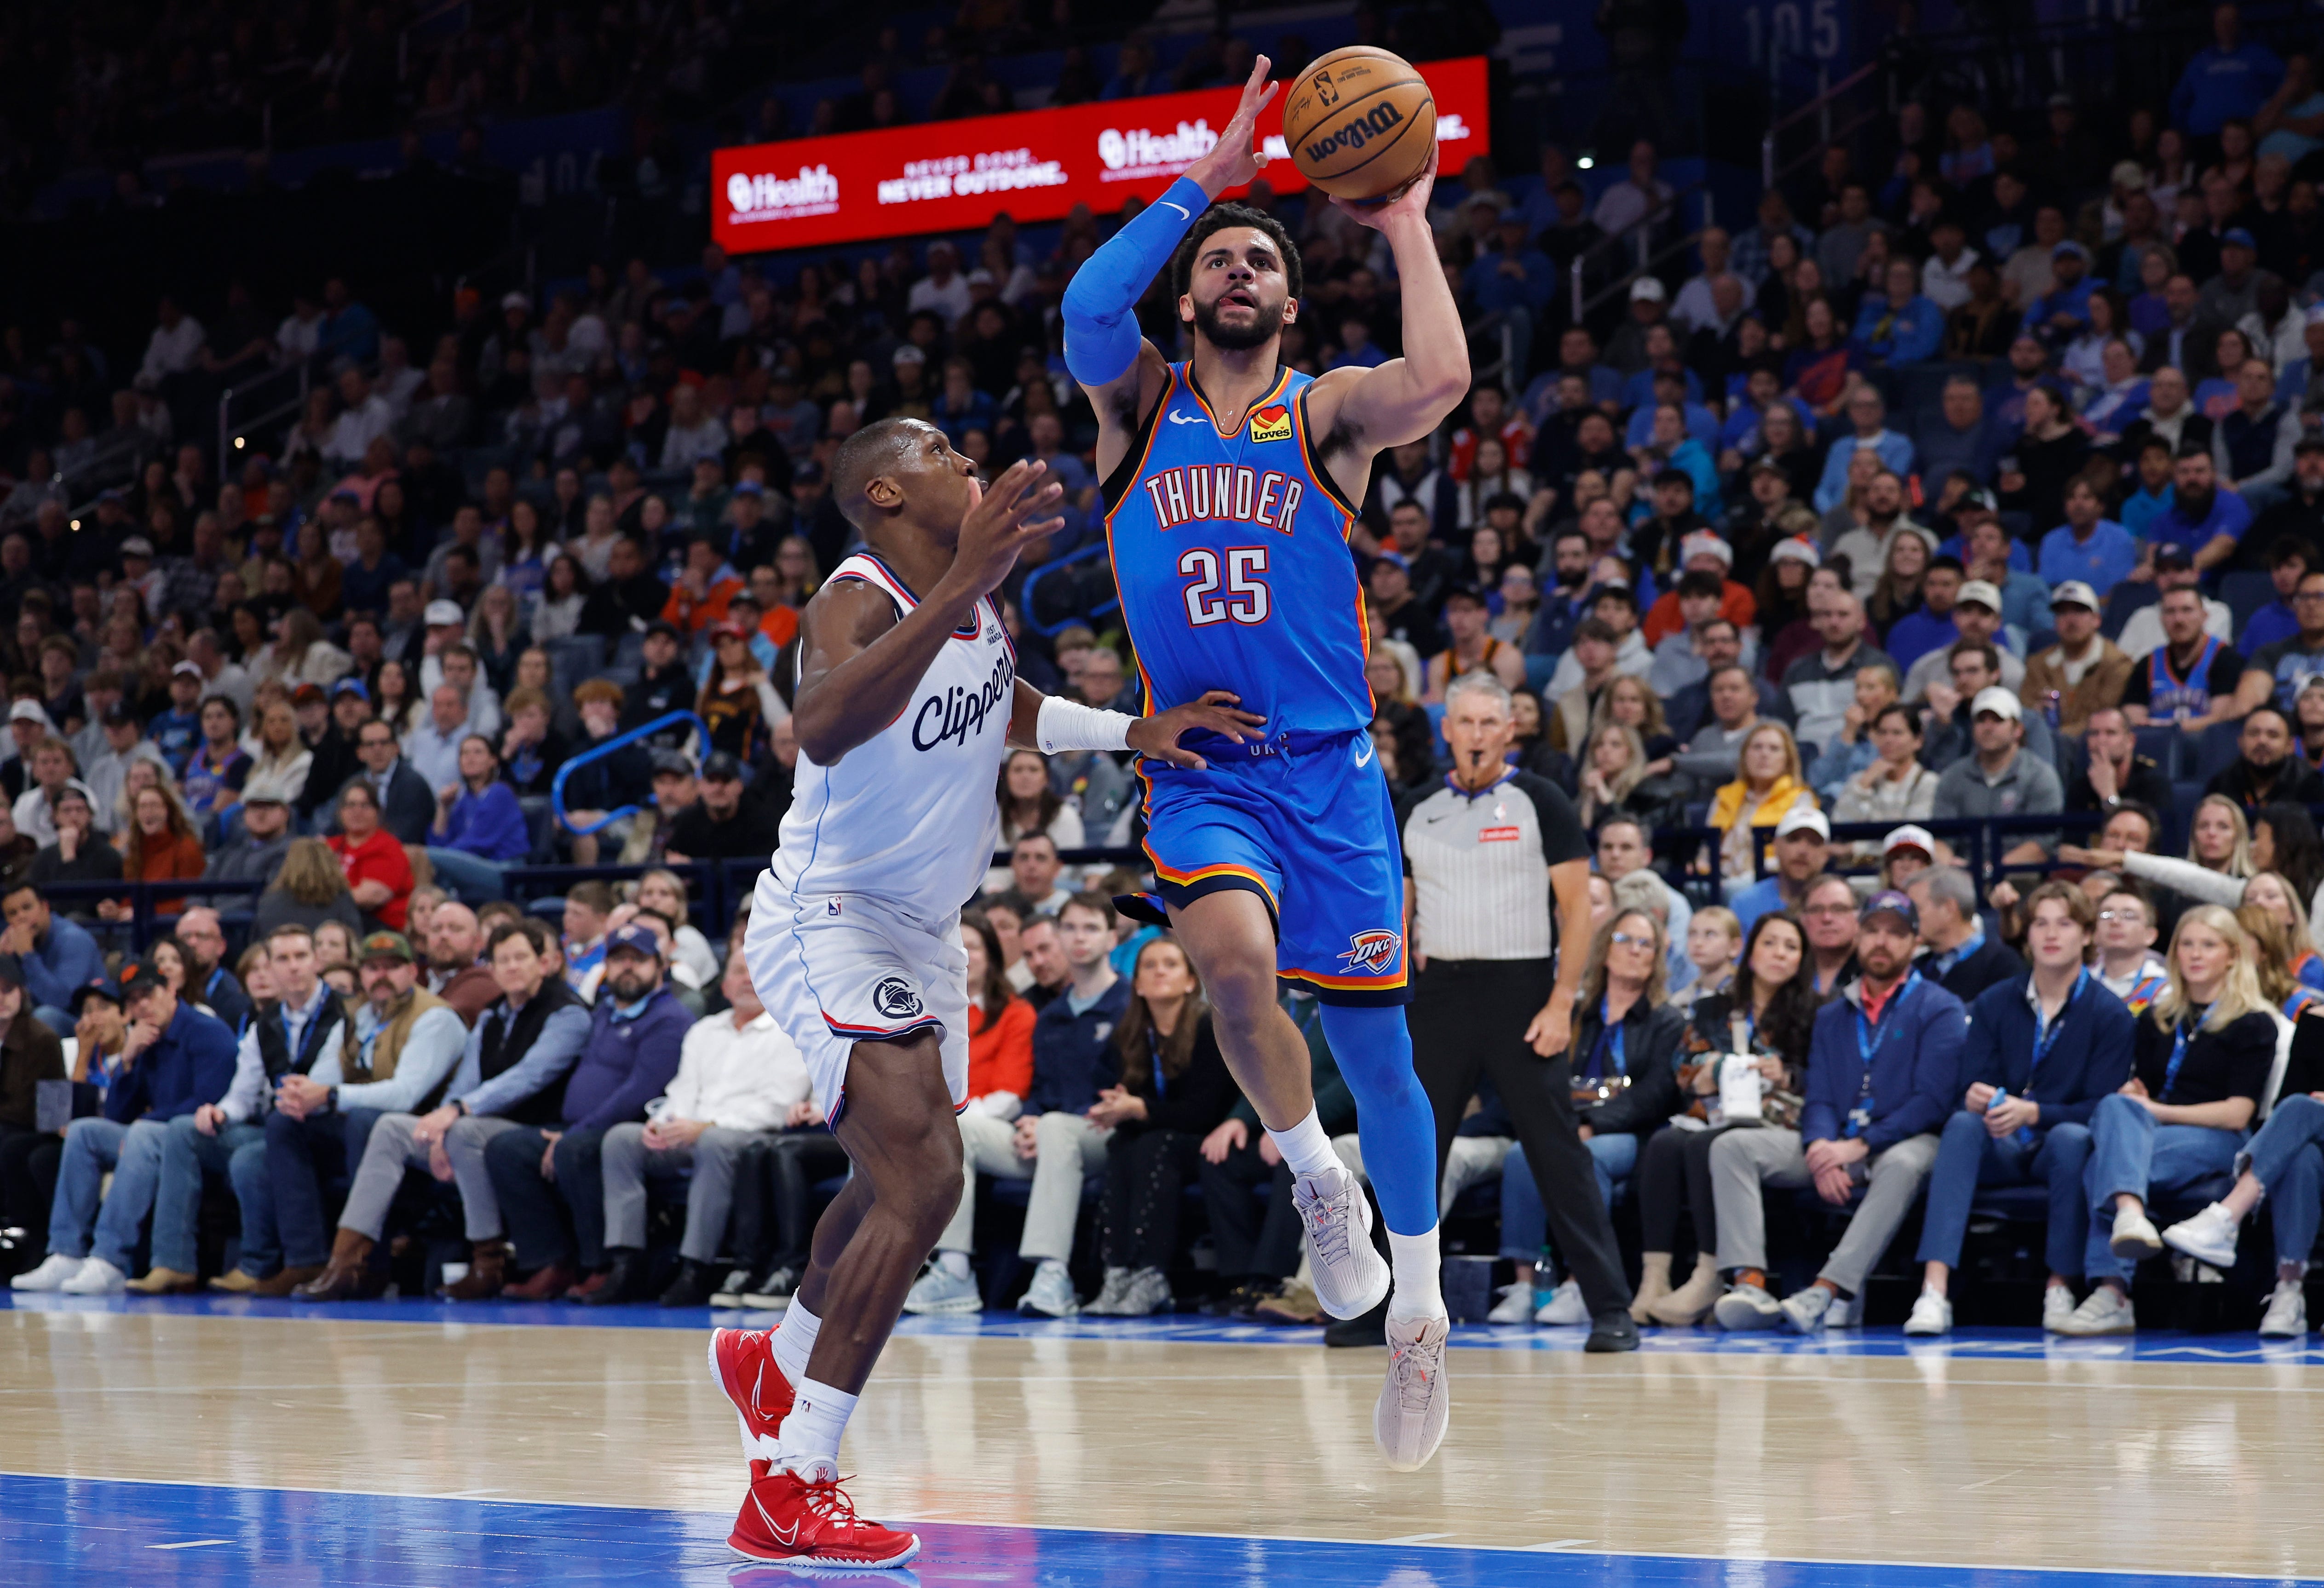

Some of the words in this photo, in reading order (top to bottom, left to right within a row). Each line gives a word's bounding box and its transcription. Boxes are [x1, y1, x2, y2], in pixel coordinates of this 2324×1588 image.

[1305, 100, 1404, 163] Wilson
[752, 163, 839, 210] Health
[878, 174, 953, 205] NEVER
[903, 155, 970, 179] NEVER
[1144, 464, 1304, 537] THUNDER
[1177, 545, 1271, 628] 25
[912, 646, 1013, 751] Clippers
[1352, 938, 1391, 964] OKC
